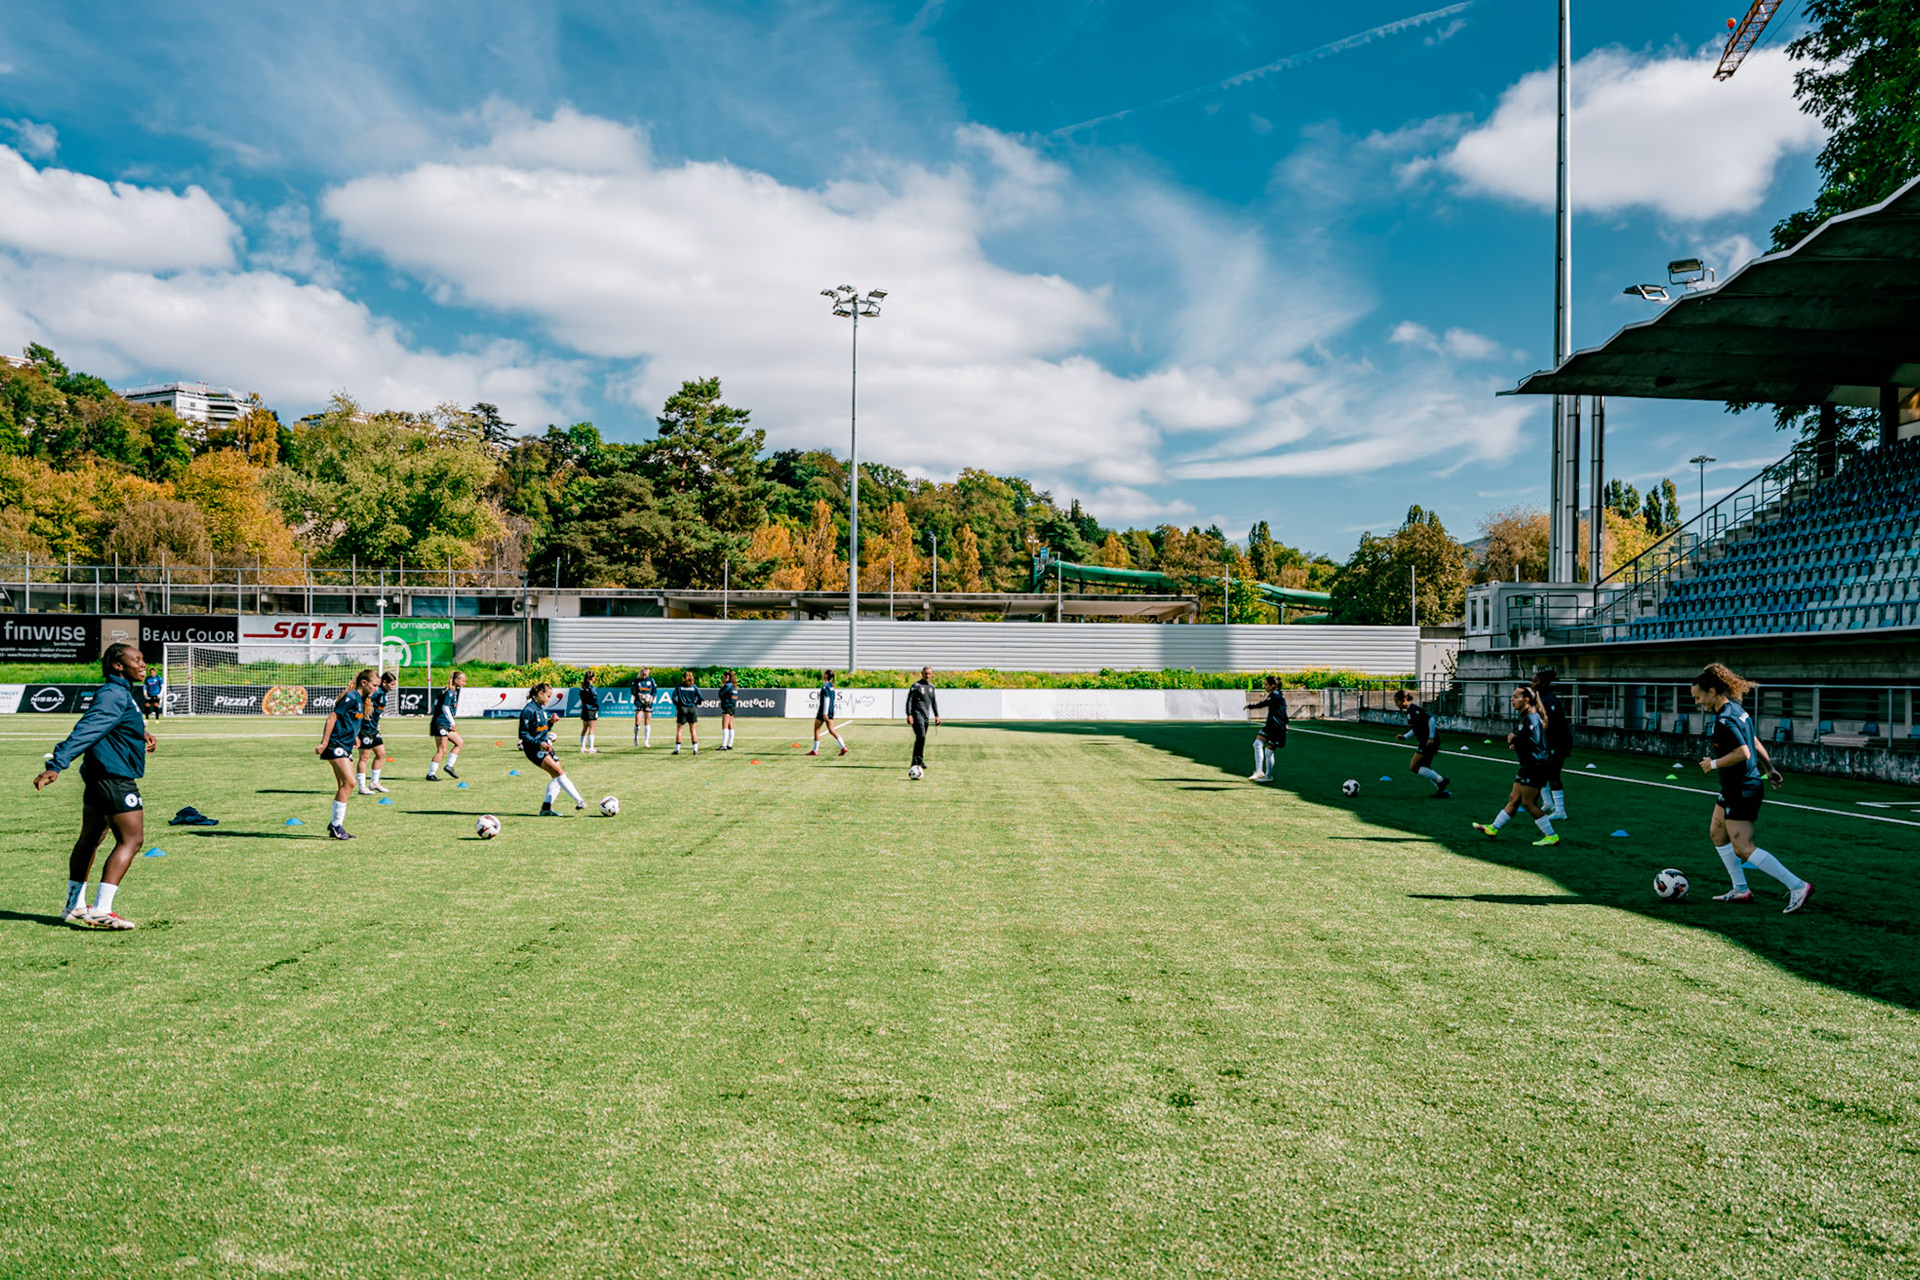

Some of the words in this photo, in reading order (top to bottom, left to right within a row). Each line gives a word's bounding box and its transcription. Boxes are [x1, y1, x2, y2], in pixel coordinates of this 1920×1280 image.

[4, 621, 86, 641] finwise
[391, 621, 450, 631] pharmacieplus
[143, 627, 180, 642] BEAU
[185, 628, 235, 642] COLOR
[213, 696, 257, 707] Pizza?
